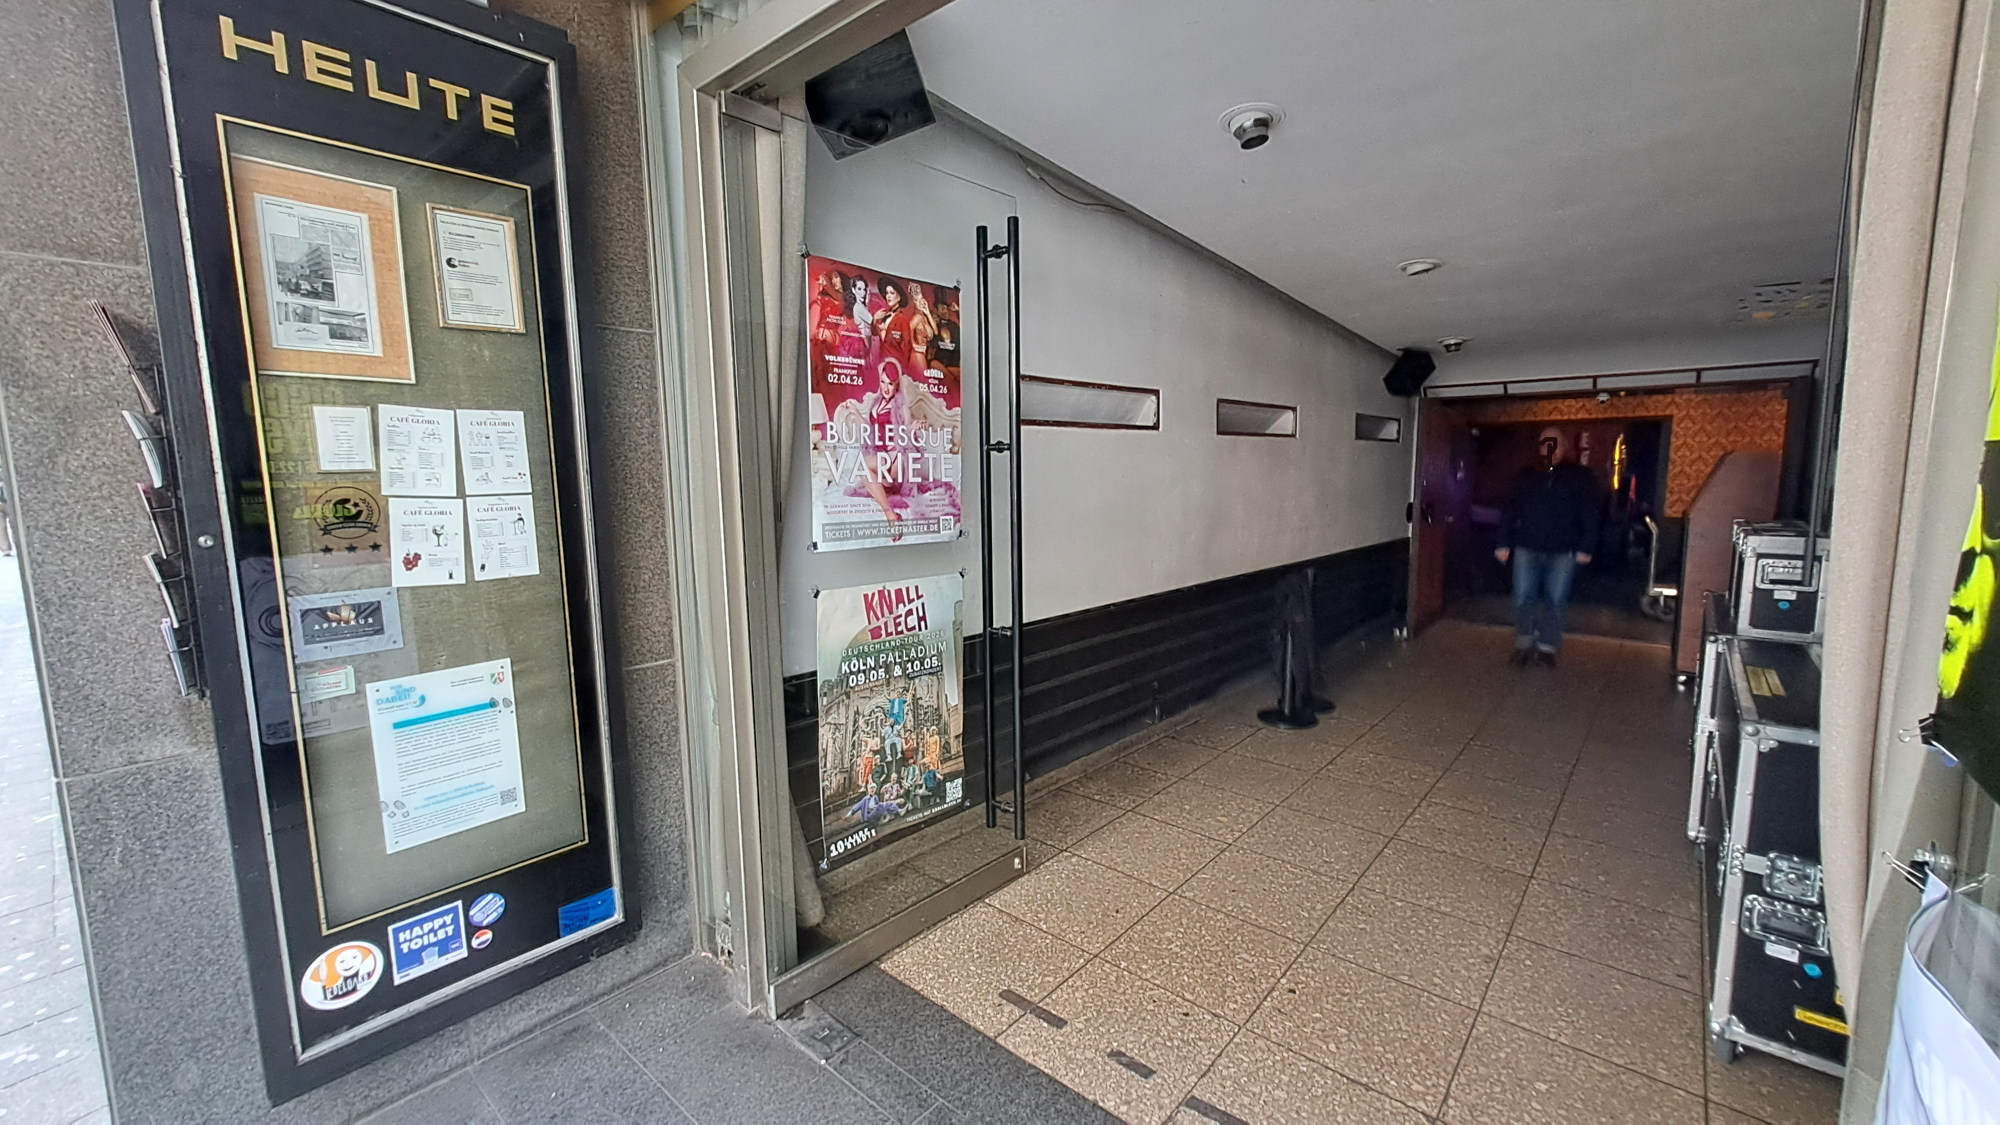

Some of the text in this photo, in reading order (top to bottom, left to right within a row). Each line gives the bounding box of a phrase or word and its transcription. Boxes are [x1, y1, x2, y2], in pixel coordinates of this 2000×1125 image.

[218, 14, 516, 137] HEUTE
[827, 373, 864, 386] 02.04.26
[919, 383, 948, 394] 05.04.26
[411, 417, 441, 426] GLORIA
[470, 419, 488, 427] CAFÉ
[826, 421, 953, 448] BURLESQUE
[403, 508, 423, 516] CAFÉ
[476, 505, 522, 513] CAFÉ GLORIA
[825, 530, 851, 540] TICKETS
[857, 524, 939, 536] WWW.TICKETMASTER.DE
[862, 584, 925, 626] KNALL
[313, 617, 374, 630] APPLAUS
[868, 601, 929, 641] BLECH
[842, 630, 945, 657] DEUTSCHLAND-TOUR 2026
[841, 640, 948, 674] KÖLN PALLADIUM
[848, 656, 942, 687] 09.05. & 10.05.
[829, 839, 845, 858] 10
[398, 912, 454, 943] HAPPY
[400, 924, 455, 954] TOILET
